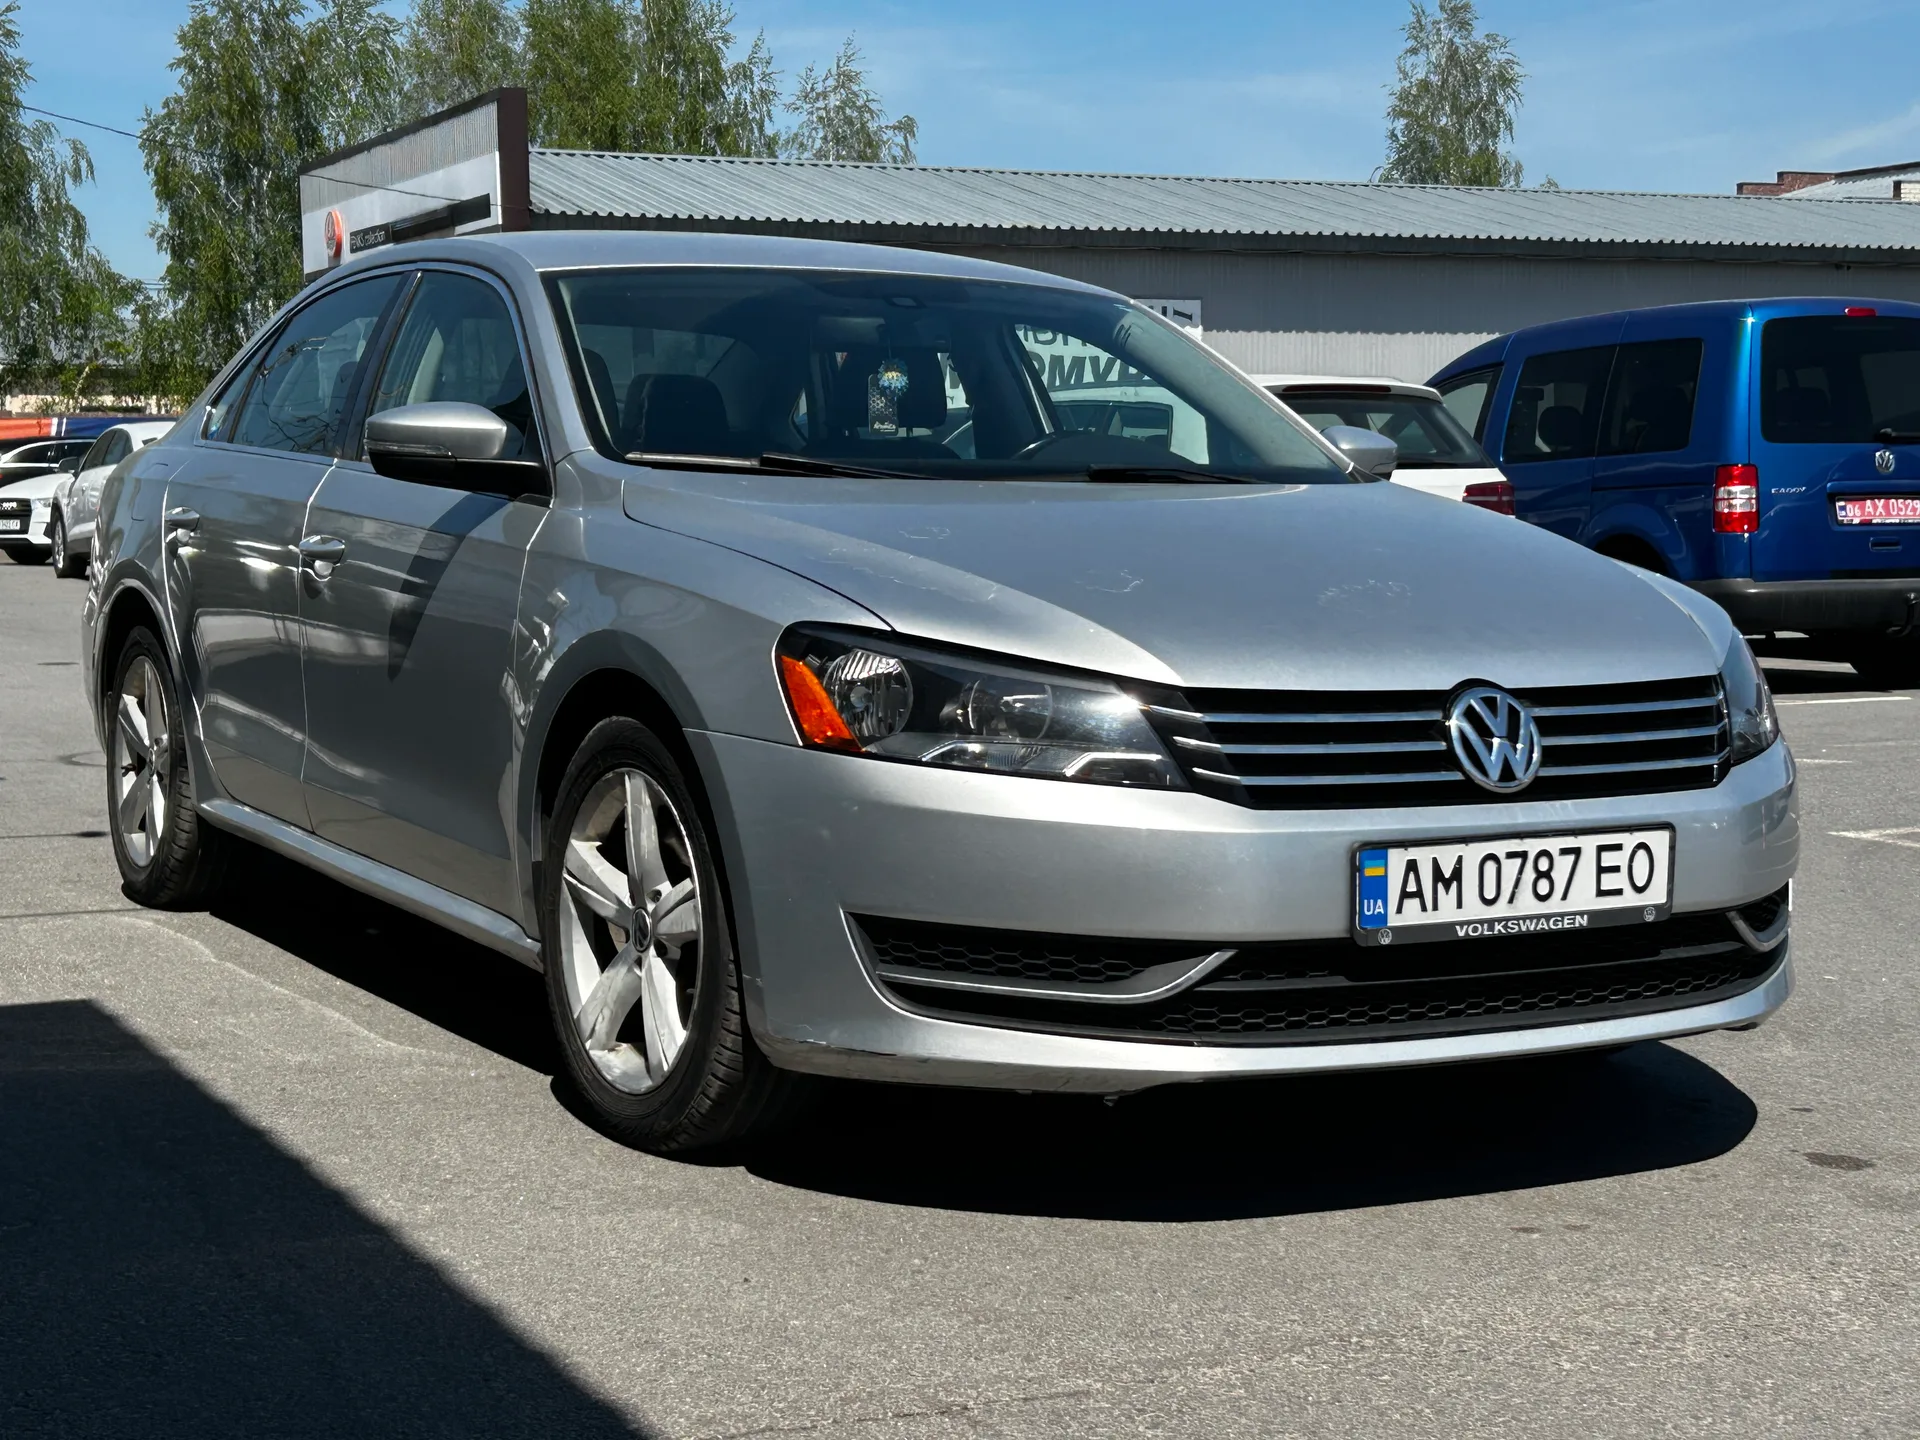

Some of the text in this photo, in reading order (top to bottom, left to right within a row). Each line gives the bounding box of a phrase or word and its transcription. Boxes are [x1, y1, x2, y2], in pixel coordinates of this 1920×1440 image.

[1846, 504, 1861, 516] 06
[1865, 499, 1885, 516] AX
[1395, 841, 1655, 914] AM 0787 EO
[1363, 898, 1385, 916] UA
[1455, 914, 1588, 938] VOLKSWAGEN
